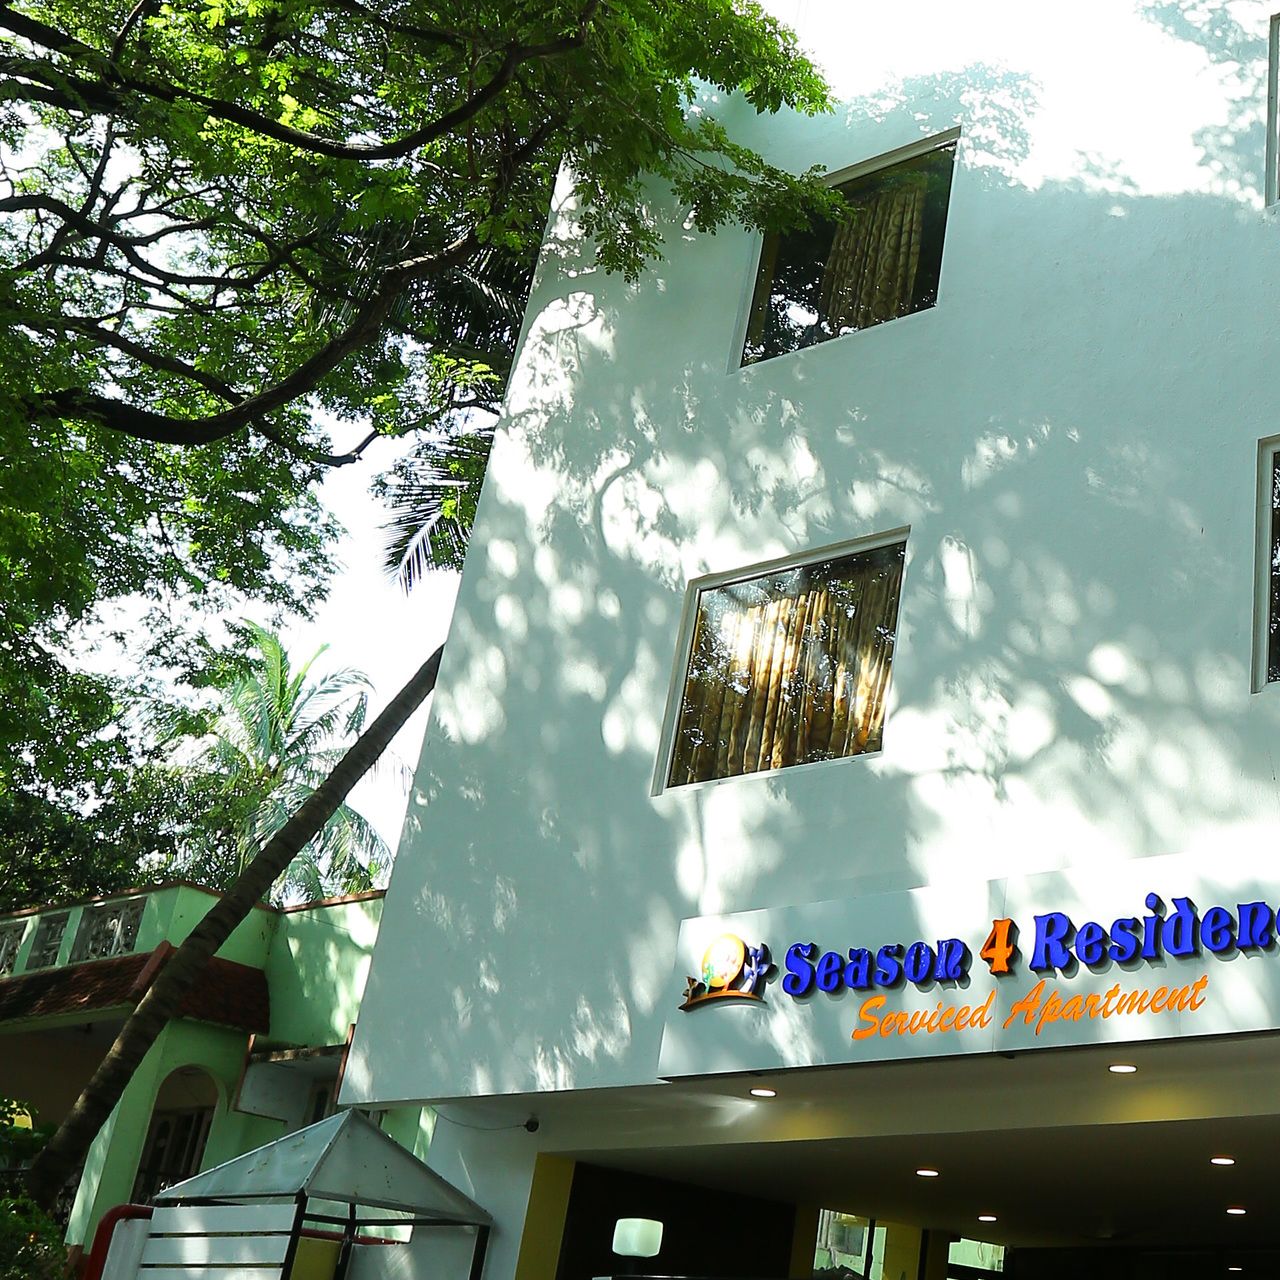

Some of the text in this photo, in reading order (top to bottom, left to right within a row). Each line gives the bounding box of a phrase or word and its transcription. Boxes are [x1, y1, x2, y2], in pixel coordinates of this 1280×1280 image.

[782, 937, 971, 999] Season
[979, 918, 1018, 976] 4
[851, 975, 1210, 1042] Serviced Apartment
